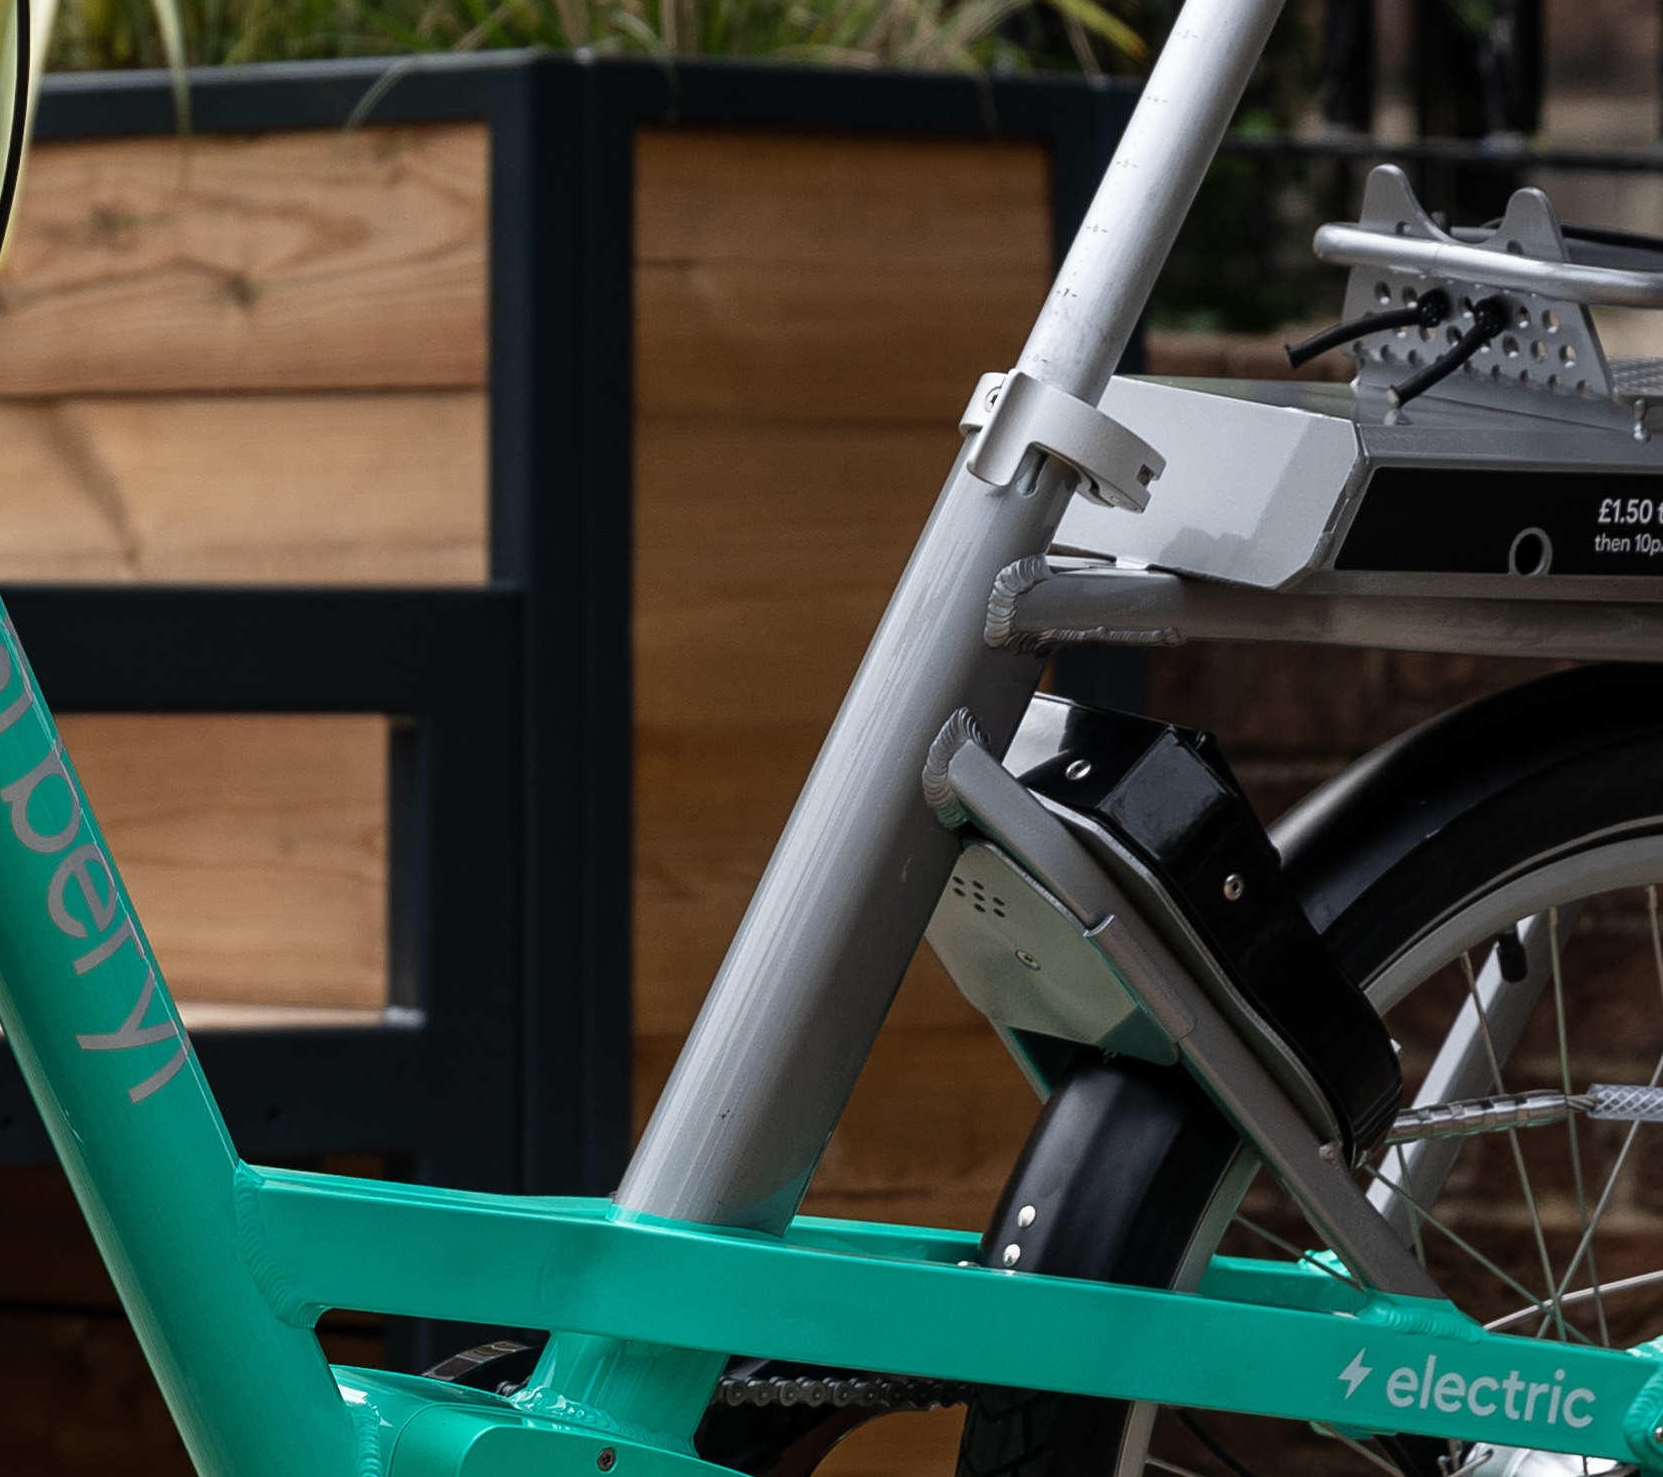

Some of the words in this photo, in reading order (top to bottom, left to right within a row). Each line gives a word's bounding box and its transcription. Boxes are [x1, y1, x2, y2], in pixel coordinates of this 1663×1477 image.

[1597, 497, 1654, 524] £1.50
[1594, 532, 1631, 552] then
[0, 734, 193, 1105] beryl
[1385, 1354, 1597, 1429] electric
